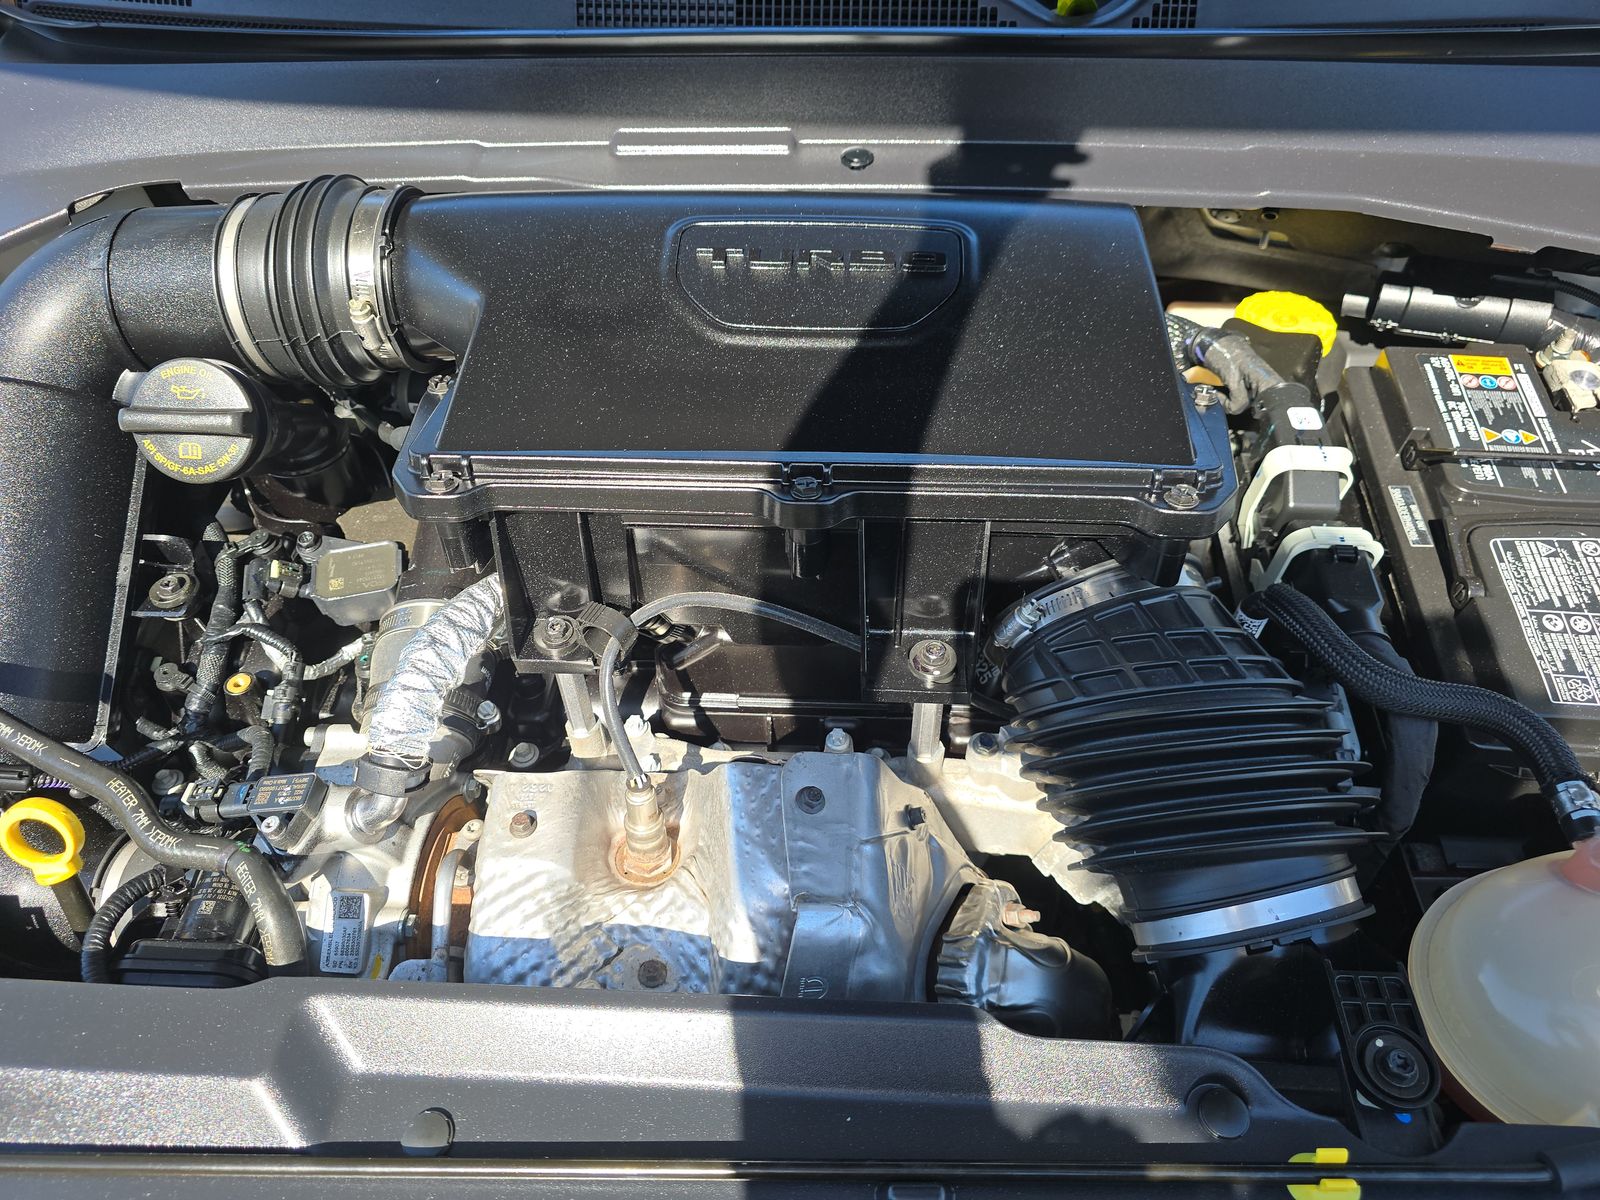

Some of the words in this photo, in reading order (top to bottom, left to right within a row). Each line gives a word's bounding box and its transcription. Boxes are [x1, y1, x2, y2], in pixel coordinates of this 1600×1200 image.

[695, 247, 947, 273] TURBO
[160, 365, 197, 380] ENGINE
[106, 777, 139, 811] HEATER
[131, 808, 152, 831] 7MM
[234, 861, 257, 898] HEATER
